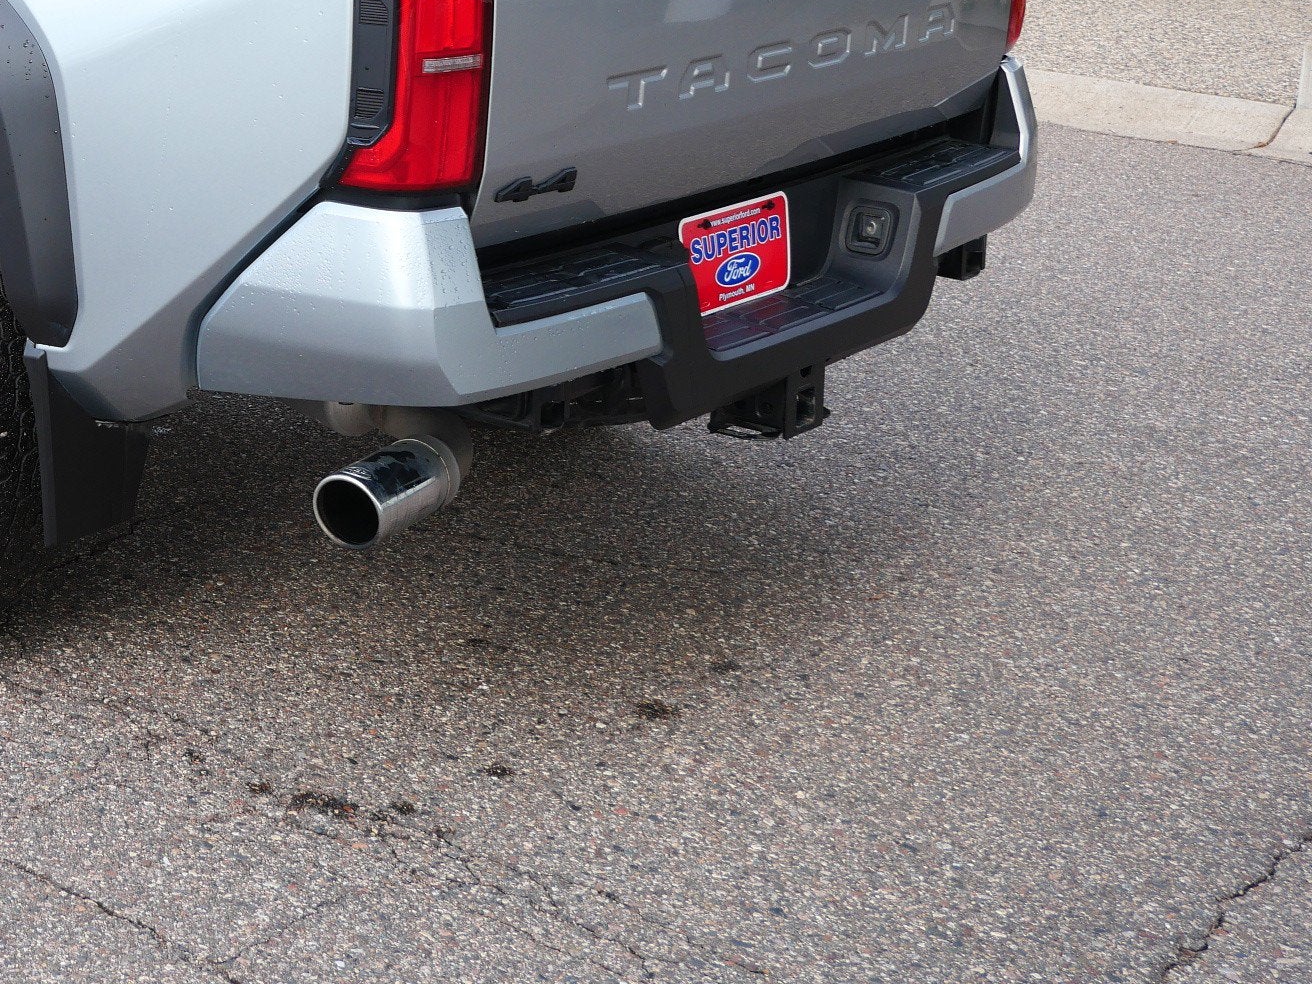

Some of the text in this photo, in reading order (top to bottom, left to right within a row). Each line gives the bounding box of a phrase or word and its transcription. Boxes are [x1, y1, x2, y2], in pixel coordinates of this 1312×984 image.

[606, 1, 956, 111] TACOMA
[690, 214, 782, 265] SUPERIOR
[724, 257, 753, 283] Ford
[718, 283, 755, 302] Plymouth, MN
